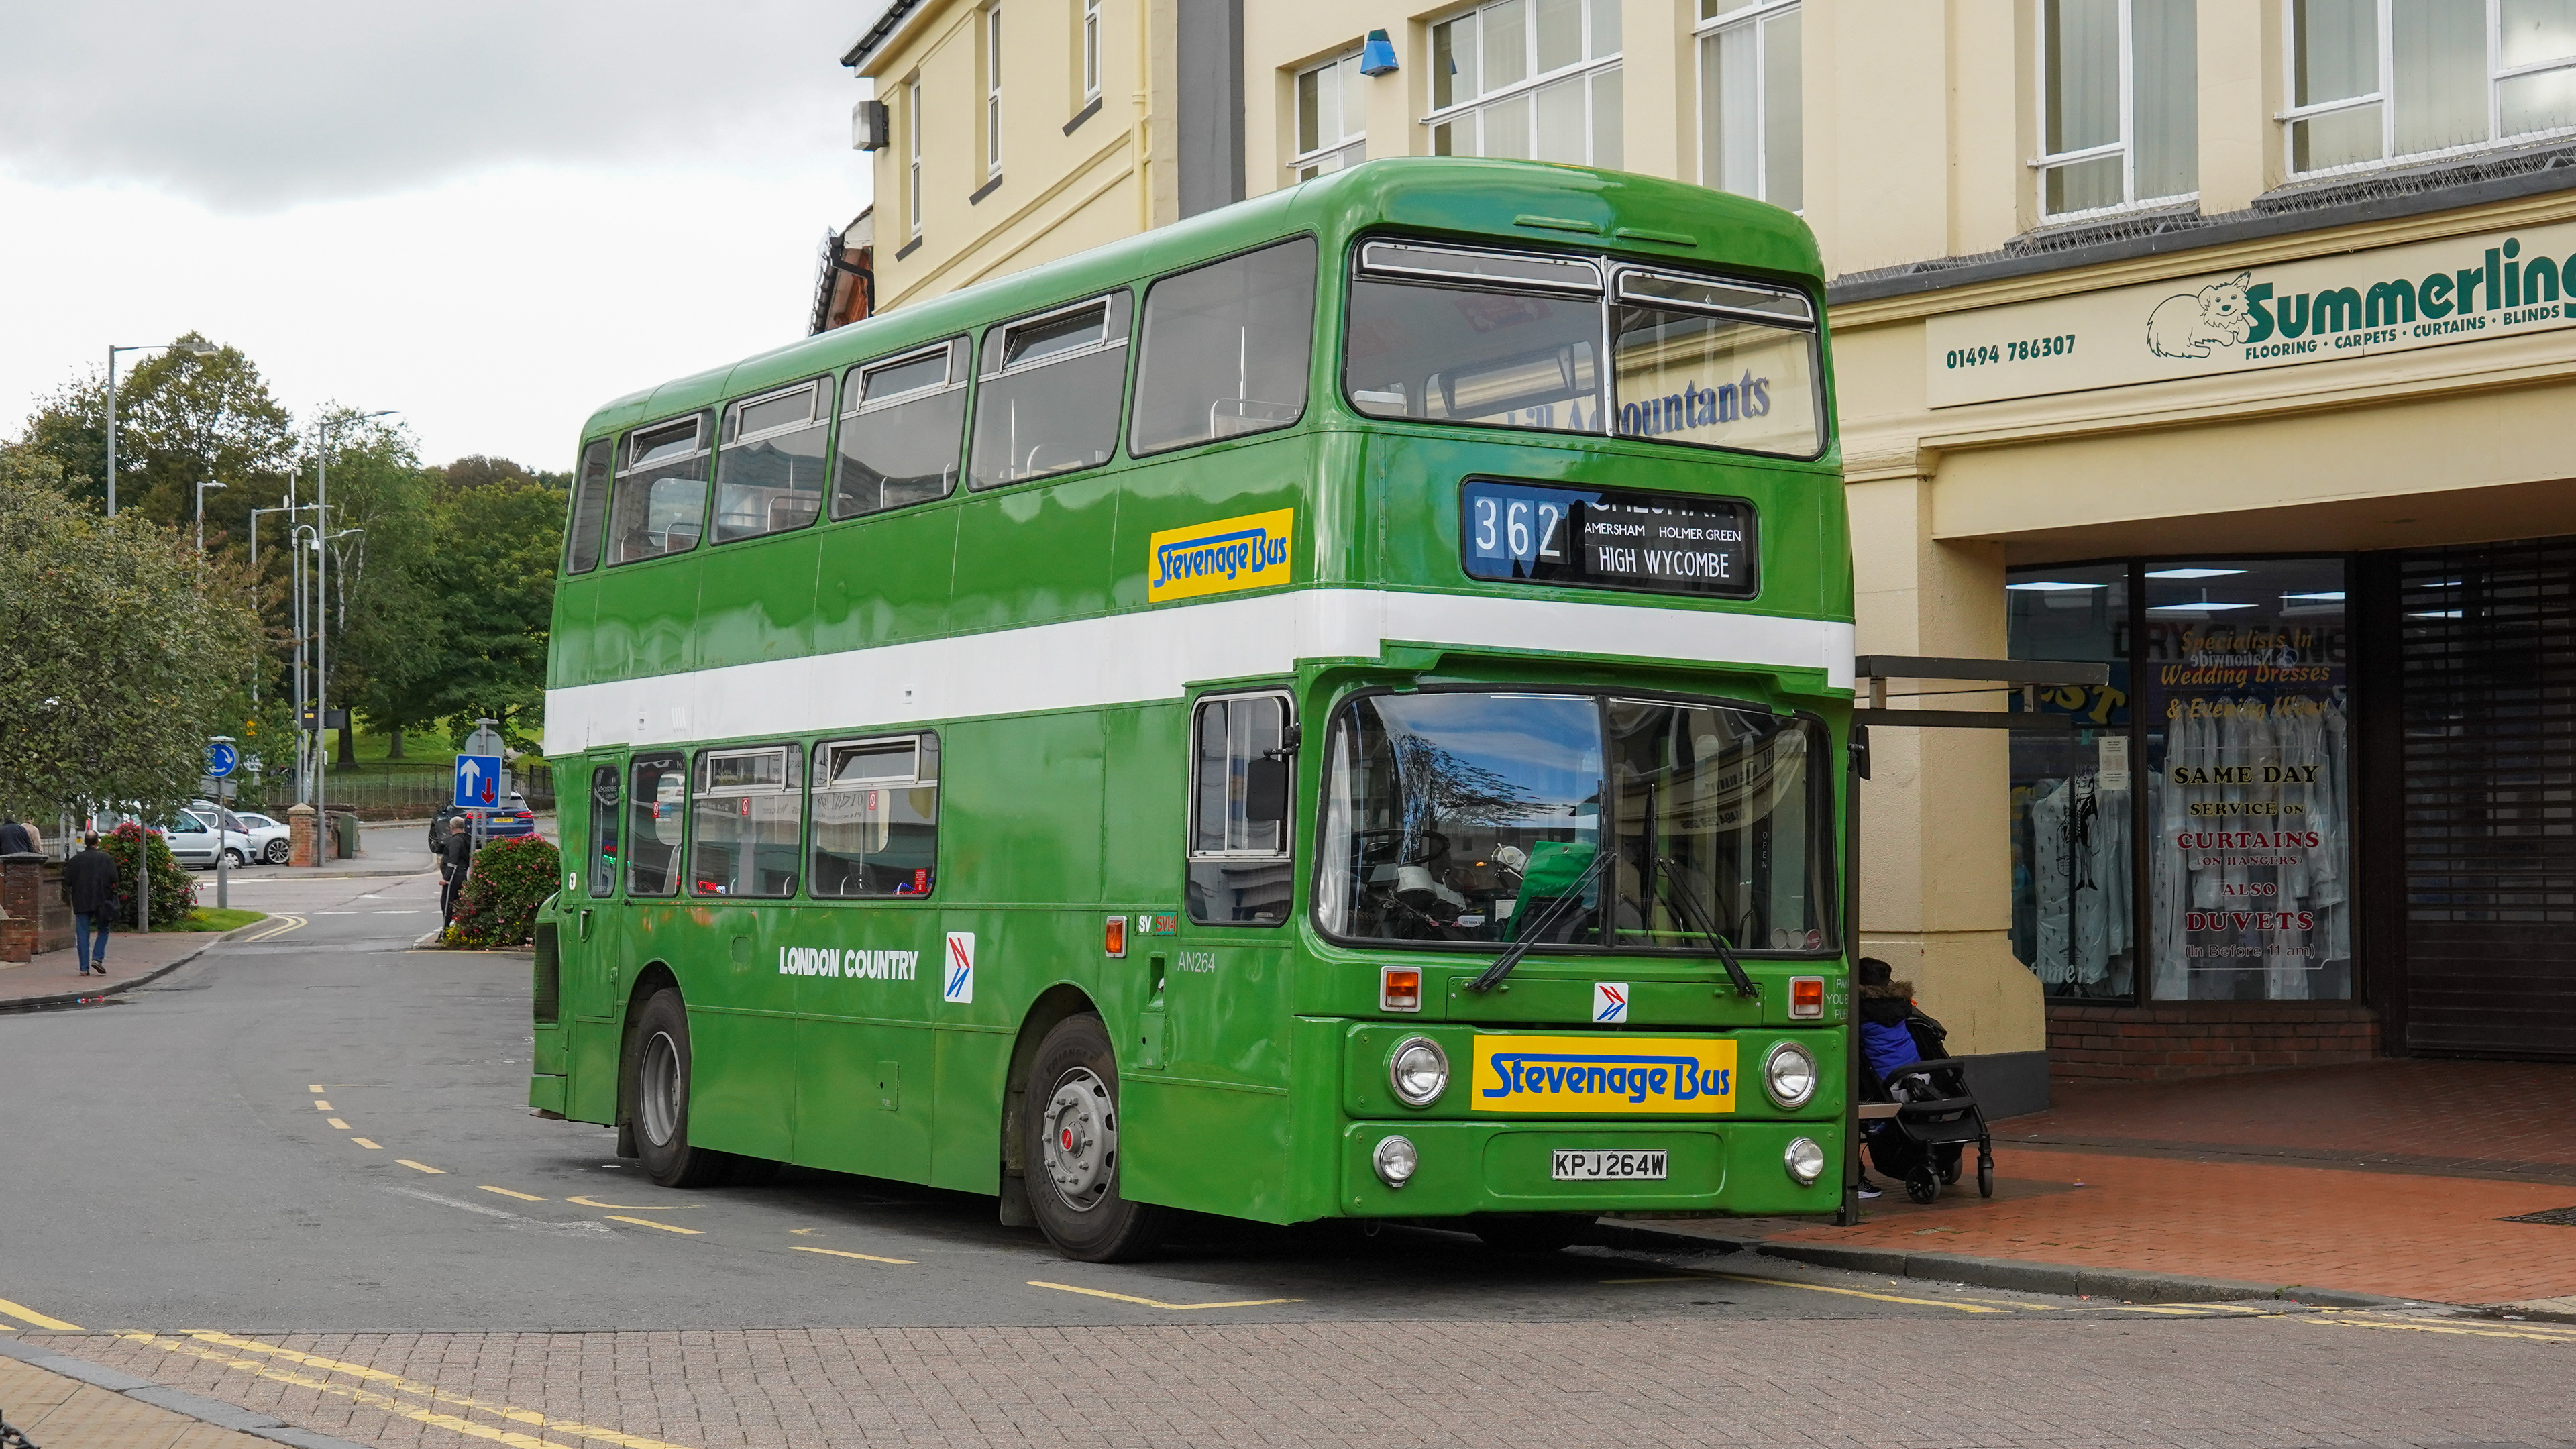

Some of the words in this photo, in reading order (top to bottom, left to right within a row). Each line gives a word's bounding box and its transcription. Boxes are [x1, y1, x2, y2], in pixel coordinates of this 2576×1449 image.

[2245, 339, 2317, 360] FLOORING
[2334, 328, 2397, 349] CARPETS
[2413, 315, 2486, 337] CURTAINS
[2503, 304, 2560, 326] BLINDS
[1947, 344, 2000, 369] 01494
[2008, 334, 2076, 363] 786307
[1476, 498, 1560, 557] 362
[1585, 522, 1646, 537] AMERSHAM
[1659, 526, 1705, 541] HOLMER
[1705, 529, 1742, 542] GREEN
[1153, 534, 1249, 588] Stevenage
[1251, 527, 1287, 573] Bus
[1599, 546, 1638, 574] HIGH
[1646, 549, 1730, 578] WYCOMBE
[2180, 629, 2286, 653] Specialists
[2294, 629, 2313, 649] In
[2161, 664, 2247, 689] Wedding
[2255, 664, 2330, 684] Dresses
[2174, 766, 2252, 784] SAME
[2263, 765, 2319, 784] DAY
[2190, 802, 2278, 816] SERVICE
[2177, 831, 2320, 850] CURTAINS
[2196, 857, 2221, 867] (ON
[2227, 856, 2303, 866] HANGERS)
[2222, 882, 2277, 896] ALSO
[1138, 915, 1152, 933] SV
[2185, 910, 2314, 932] DUVETS
[1177, 951, 1215, 973] AN264
[2185, 945, 2204, 959] (In
[2209, 945, 2261, 957] Before
[2267, 944, 2282, 957] 11
[2286, 944, 2315, 959] am)
[779, 947, 840, 977] LONDON
[844, 949, 919, 980] COUNTRY
[1825, 993, 1844, 1005] YOU
[1482, 1053, 1668, 1104] Stevenage
[1673, 1055, 1731, 1101] Bus
